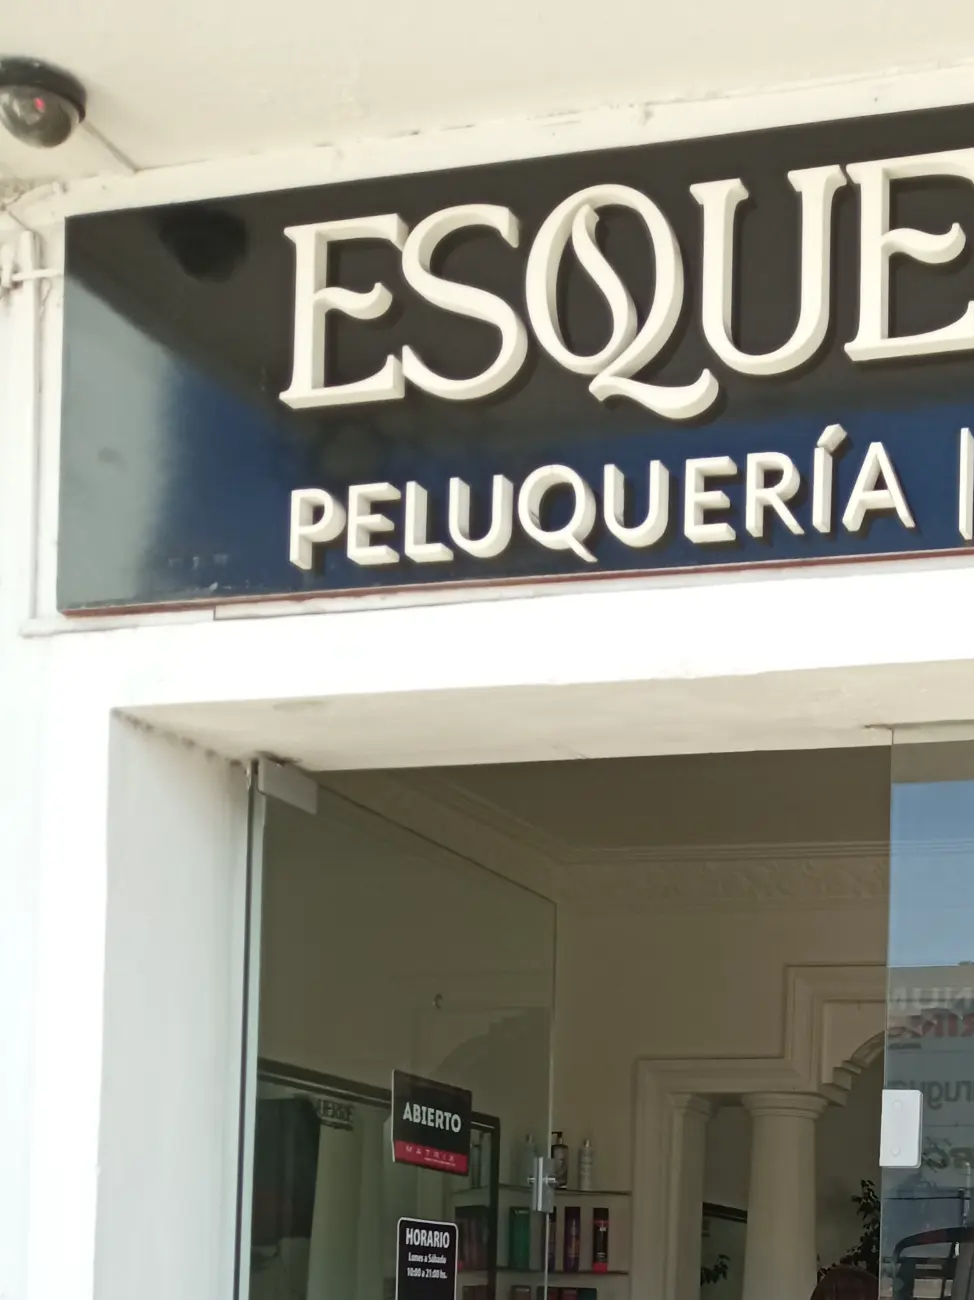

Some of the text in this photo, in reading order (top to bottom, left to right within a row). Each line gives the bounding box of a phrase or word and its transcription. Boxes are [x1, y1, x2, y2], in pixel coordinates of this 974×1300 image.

[288, 423, 916, 570] PELUQUERÍA
[402, 1101, 462, 1133] ABIERTO
[405, 1145, 456, 1163] MATRIX
[405, 1227, 450, 1249] HORARIO
